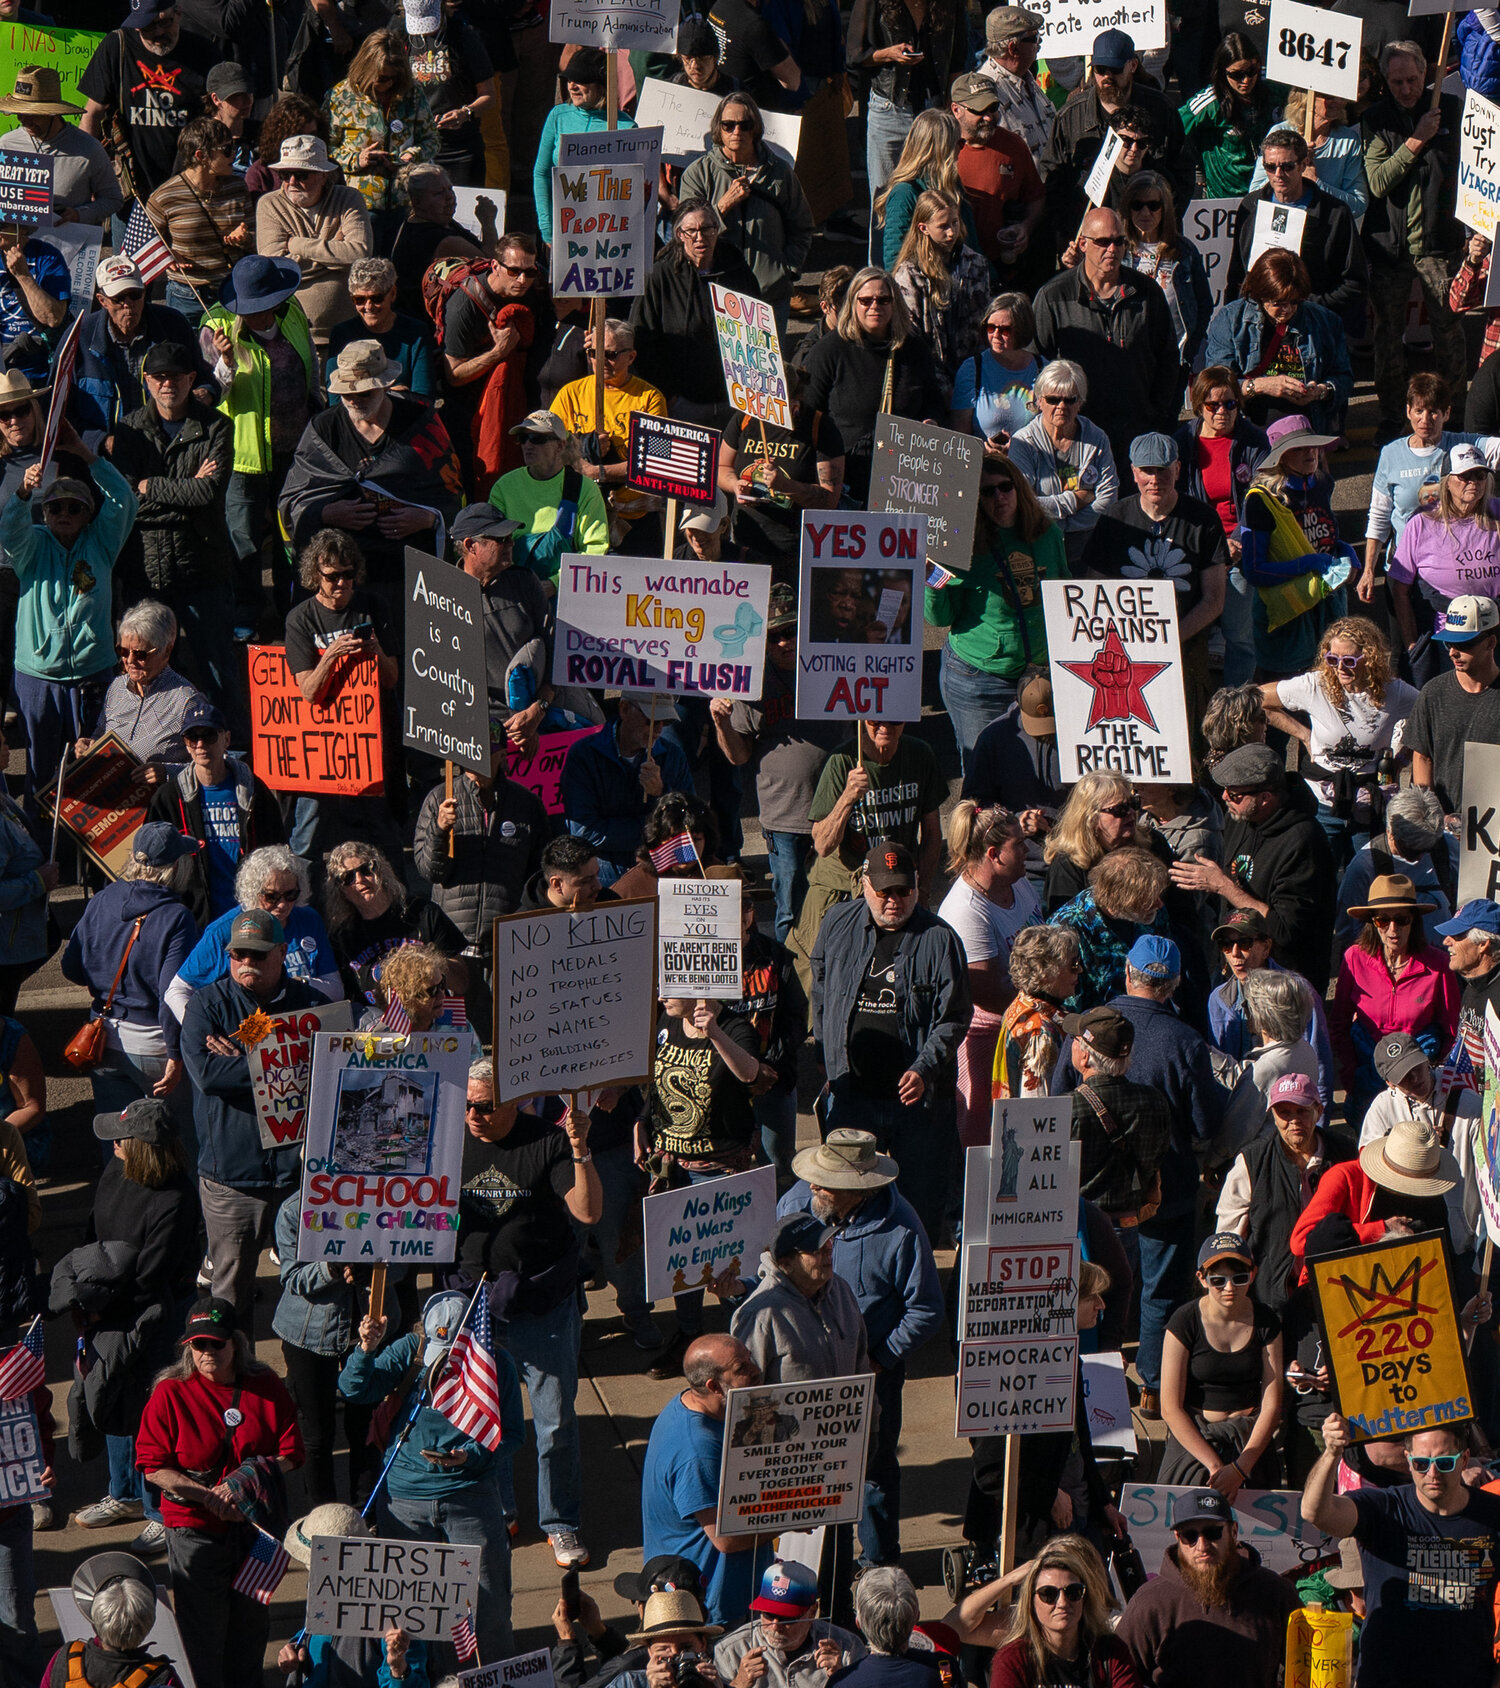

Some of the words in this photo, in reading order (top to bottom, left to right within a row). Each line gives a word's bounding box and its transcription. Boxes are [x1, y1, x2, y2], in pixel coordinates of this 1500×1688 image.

[557, 13, 598, 33] Trump
[602, 15, 674, 39] Administration
[1092, 6, 1154, 28] another!
[1278, 27, 1350, 69] 8647
[567, 142, 611, 156] Planet
[615, 140, 659, 155] Trump
[1473, 146, 1496, 174] Try
[25, 166, 50, 184] YET?
[639, 418, 711, 444] PRO-AMERICA
[889, 423, 905, 447] The
[910, 432, 940, 453] power
[943, 436, 954, 458] of
[957, 439, 970, 463] the
[899, 451, 929, 476] people
[933, 456, 942, 475] is
[805, 522, 866, 560] YES
[879, 526, 918, 560] ON
[1456, 565, 1500, 581] TRUMP
[1063, 583, 1161, 620] RAGE
[429, 621, 441, 644] is
[451, 634, 461, 652] a
[1072, 616, 1172, 644] AGAINST
[566, 629, 670, 658] Deserves
[684, 644, 699, 659] a
[799, 655, 856, 674] VOTING
[866, 655, 916, 673] RIGHTS
[824, 677, 889, 714] ACT
[441, 699, 456, 717] of
[1094, 724, 1142, 746] THE
[672, 882, 730, 895] HISTORY
[683, 904, 718, 915] EYES
[683, 923, 718, 936] YOU
[663, 942, 678, 954] WE
[680, 942, 710, 954] AREN'T
[711, 942, 738, 954] BEING
[664, 953, 738, 972] GOVERNED
[664, 973, 687, 984] WE'RE
[689, 973, 710, 984] BEING
[711, 973, 738, 984] LOOTED
[346, 1053, 429, 1070] AMERICA
[509, 1053, 533, 1067] ON
[540, 1038, 610, 1058] BUILDINGS
[510, 1071, 530, 1086] OR
[540, 1050, 633, 1077] CURRENCIES
[1033, 1116, 1057, 1133] WE
[1030, 1145, 1061, 1162] ARE
[308, 1174, 457, 1208] SCHOOL
[1029, 1173, 1057, 1190] ALL
[472, 1188, 503, 1198] HENRY
[505, 1188, 532, 1198] BAND
[991, 1210, 1063, 1226] IMMIGRANTS
[324, 1240, 346, 1255] AT
[360, 1240, 374, 1255] A
[389, 1240, 434, 1257] TIME
[999, 1255, 1060, 1282] STOP
[968, 1281, 1005, 1297] MASS
[968, 1294, 1055, 1314] DEPORTATION
[1355, 1317, 1434, 1362] 220
[965, 1345, 1074, 1367] DEMOCRACY
[999, 1375, 1037, 1392] NOT
[1389, 1383, 1418, 1404] to
[785, 1389, 833, 1406] COME
[839, 1385, 865, 1400] ON
[803, 1402, 863, 1421] PEOPLE
[967, 1397, 1068, 1419] OLIGARCHY
[816, 1419, 861, 1437] NOW
[743, 1443, 781, 1458] SMILE
[785, 1442, 805, 1453] ON
[810, 1438, 847, 1450] YOUR
[765, 1452, 823, 1468] BROTHER
[738, 1463, 818, 1482] EVERYBODY
[823, 1460, 848, 1471] GET
[729, 1493, 757, 1505] AND
[760, 1486, 822, 1501] IMPEACH
[826, 1481, 853, 1494] THIS
[759, 1474, 825, 1491] TOGETHER
[747, 1513, 788, 1526] RIGHT
[791, 1508, 826, 1521] NOW
[339, 1541, 455, 1578] FIRST
[316, 1575, 467, 1604] AMENDMENT
[463, 1670, 499, 1688] RESIST
[503, 1655, 548, 1678] FASCISM
